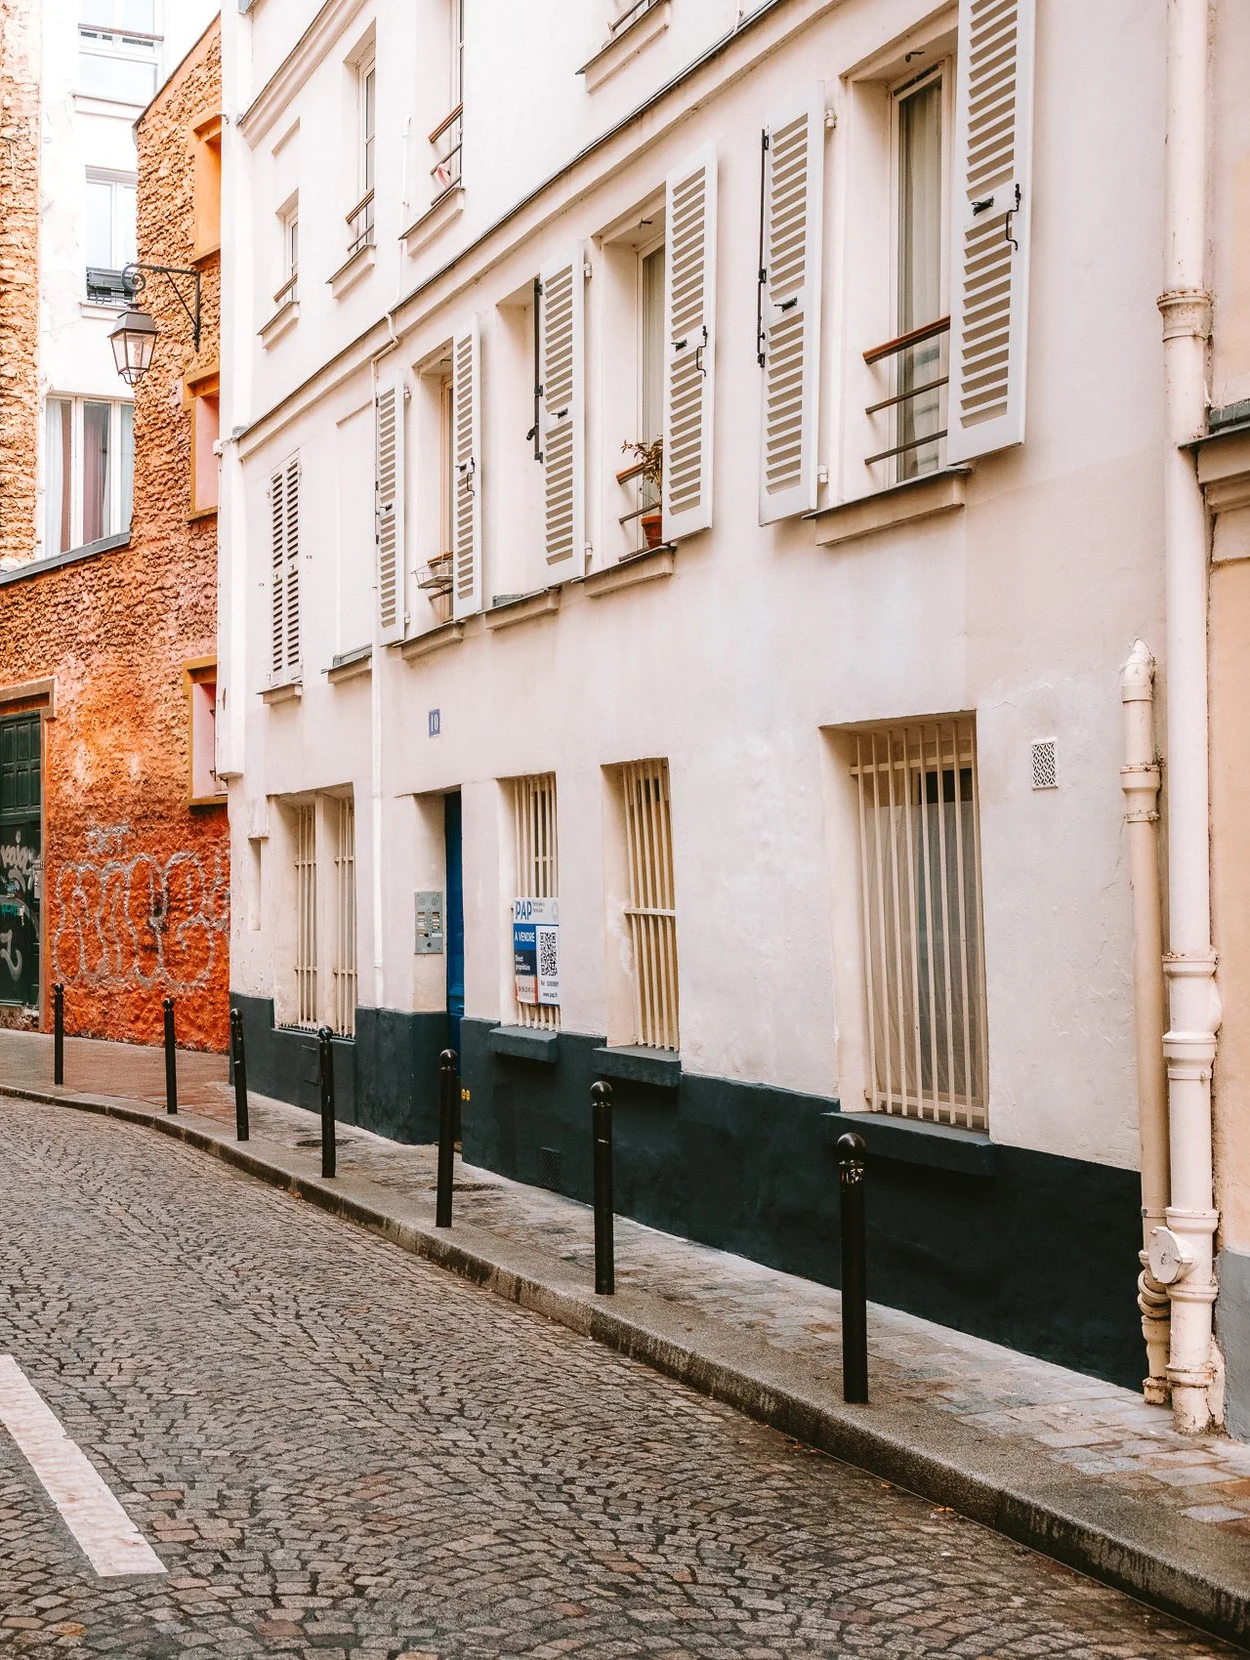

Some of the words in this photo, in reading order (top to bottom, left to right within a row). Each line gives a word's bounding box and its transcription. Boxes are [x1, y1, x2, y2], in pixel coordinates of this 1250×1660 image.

[430, 713, 439, 732] 10
[514, 900, 532, 920] PAP
[519, 931, 535, 943] VENDRE
